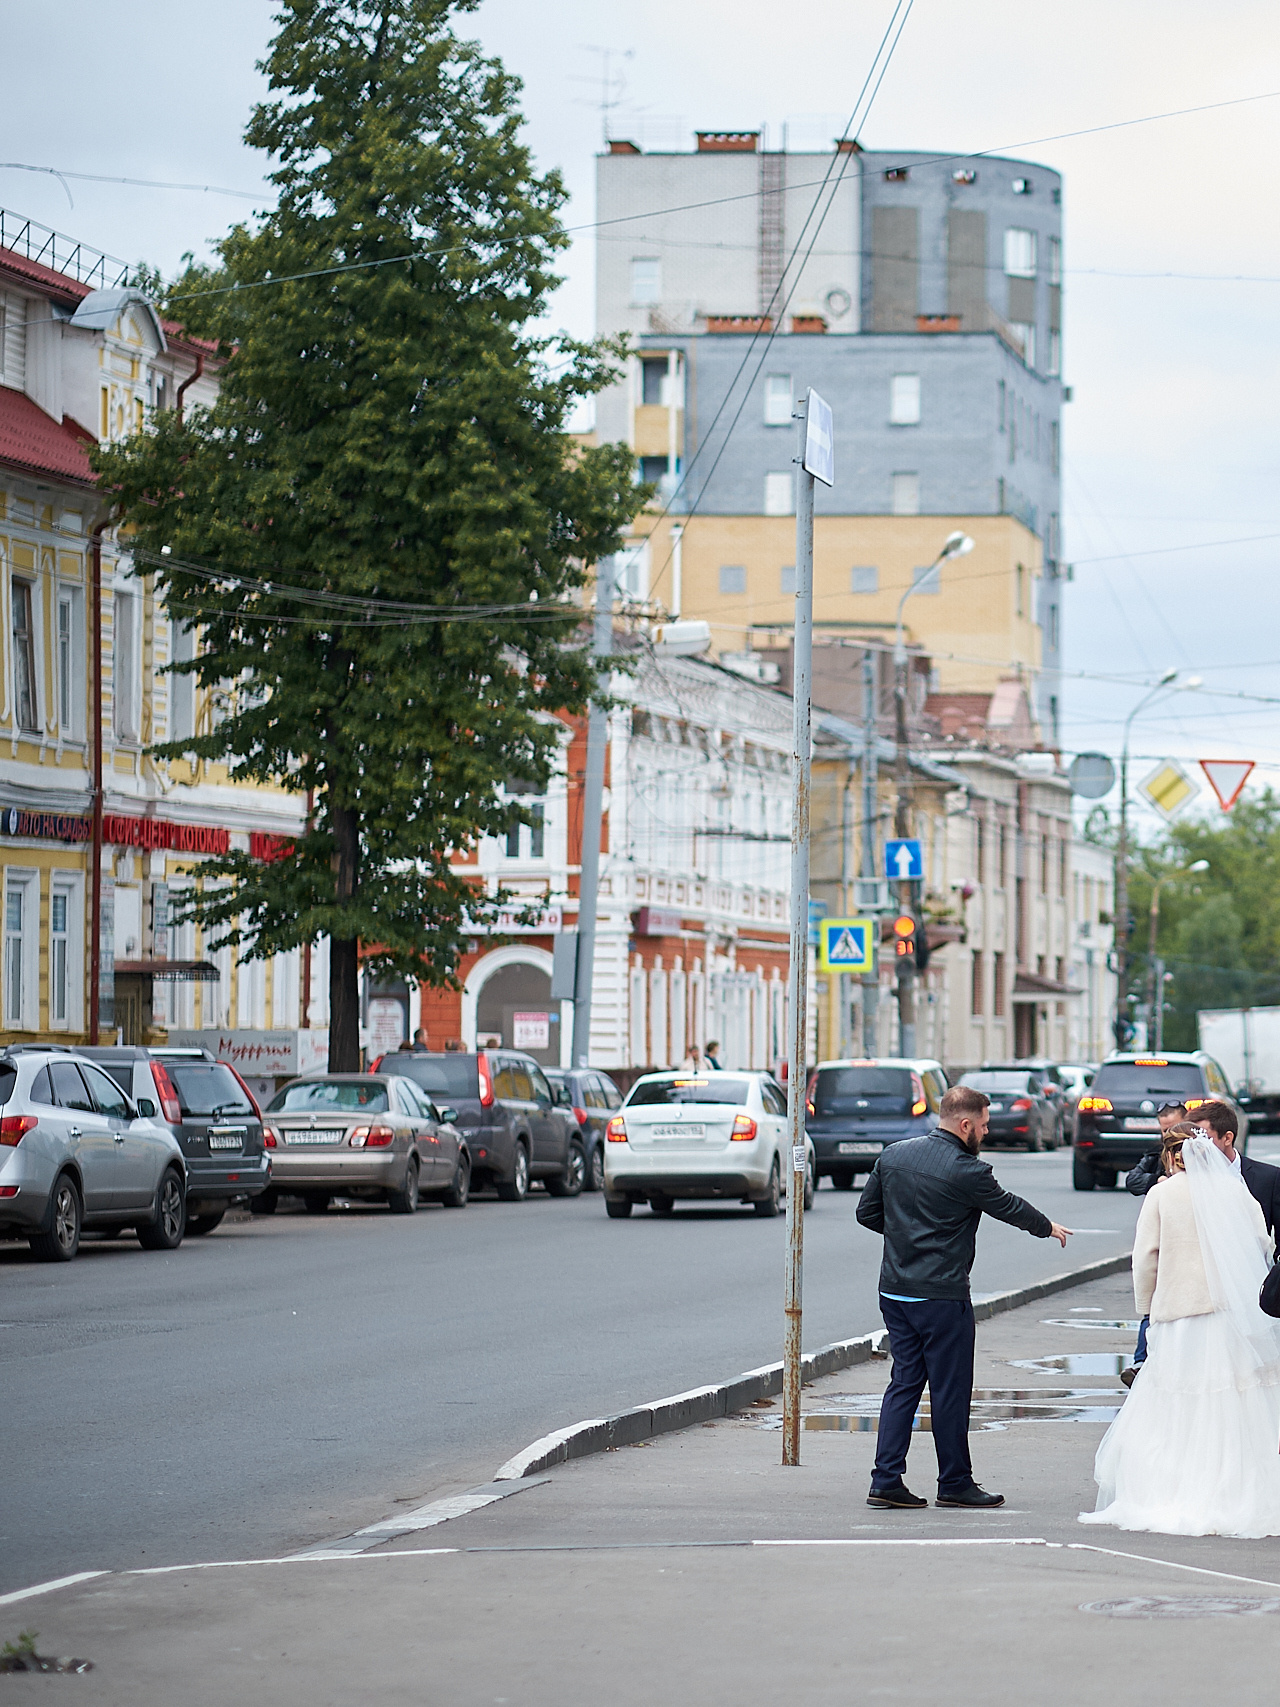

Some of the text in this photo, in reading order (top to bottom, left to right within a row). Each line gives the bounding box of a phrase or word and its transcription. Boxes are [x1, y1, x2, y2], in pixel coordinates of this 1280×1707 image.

[17, 810, 93, 842] АВТО НА СВАДЬБУ
[896, 940, 914, 956] 31
